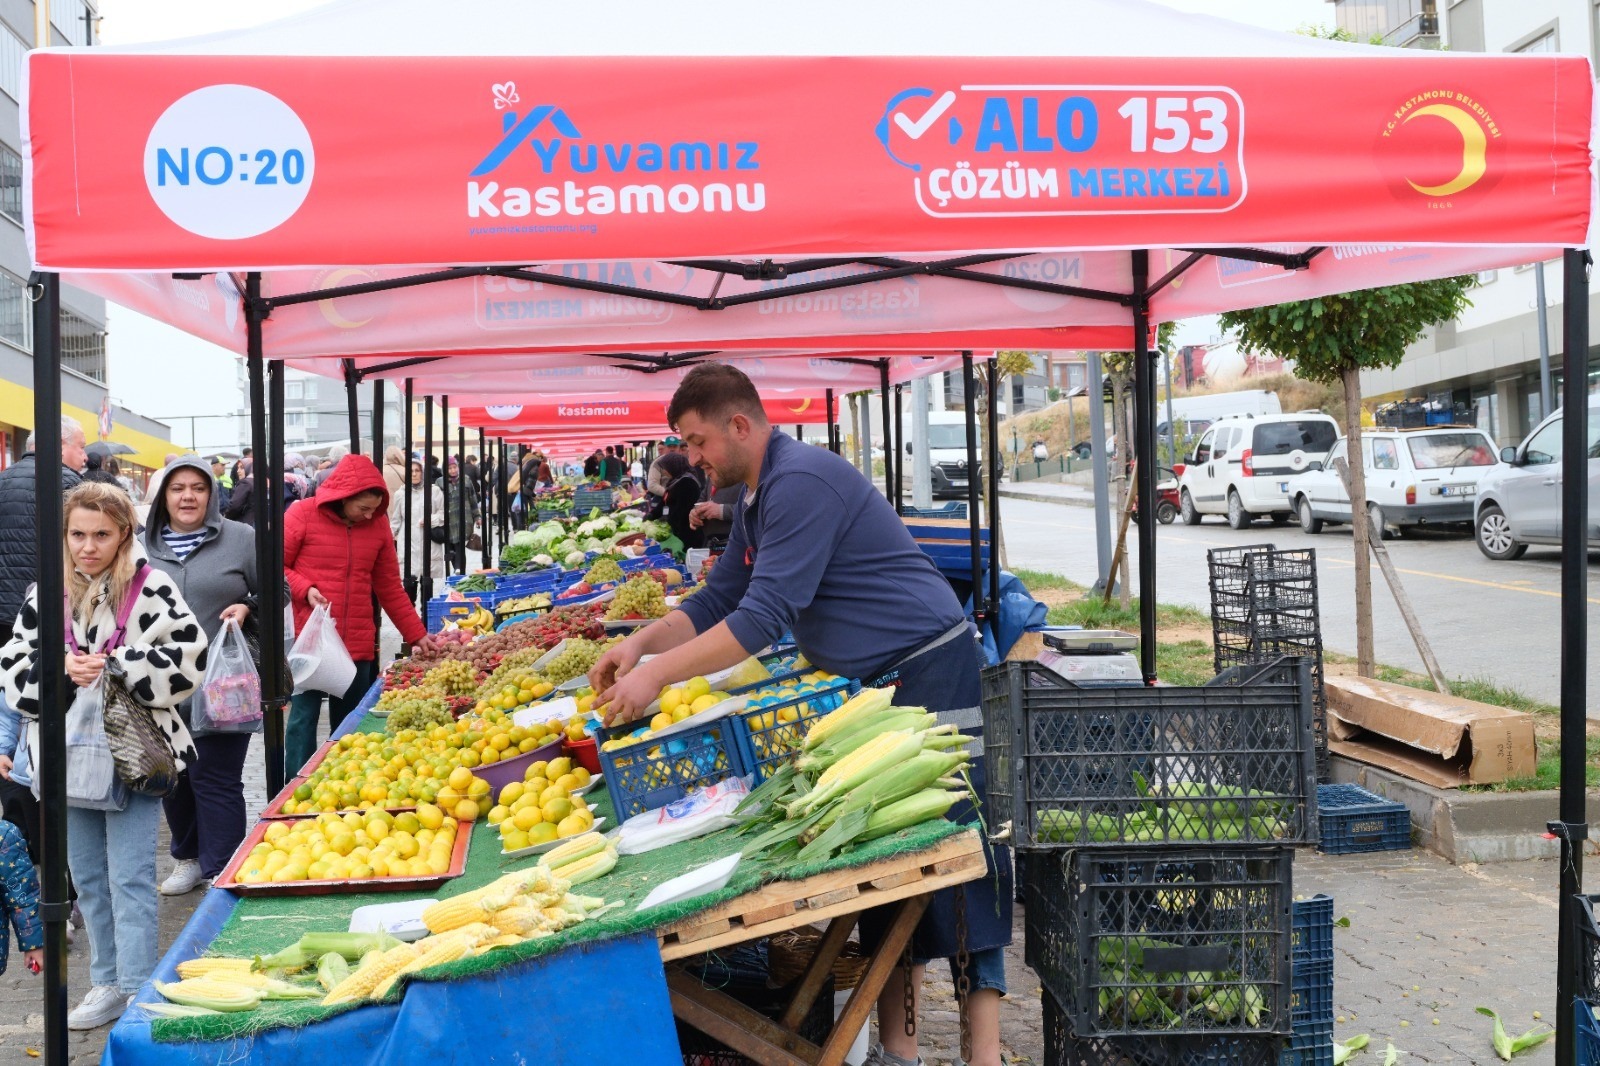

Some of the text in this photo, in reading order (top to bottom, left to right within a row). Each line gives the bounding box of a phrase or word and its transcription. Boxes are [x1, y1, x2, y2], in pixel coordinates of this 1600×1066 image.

[974, 96, 1229, 153] ALO 153
[1393, 90, 1454, 120] KASTAMONU
[1456, 93, 1502, 139] BELEDİYESİ
[157, 146, 305, 187] NO:20
[530, 138, 760, 174] Yuvamız
[467, 180, 766, 218] Kastamonu
[928, 161, 1230, 207] ÇÖZÜM MERKEZİ
[557, 406, 630, 417] Kastamonu
